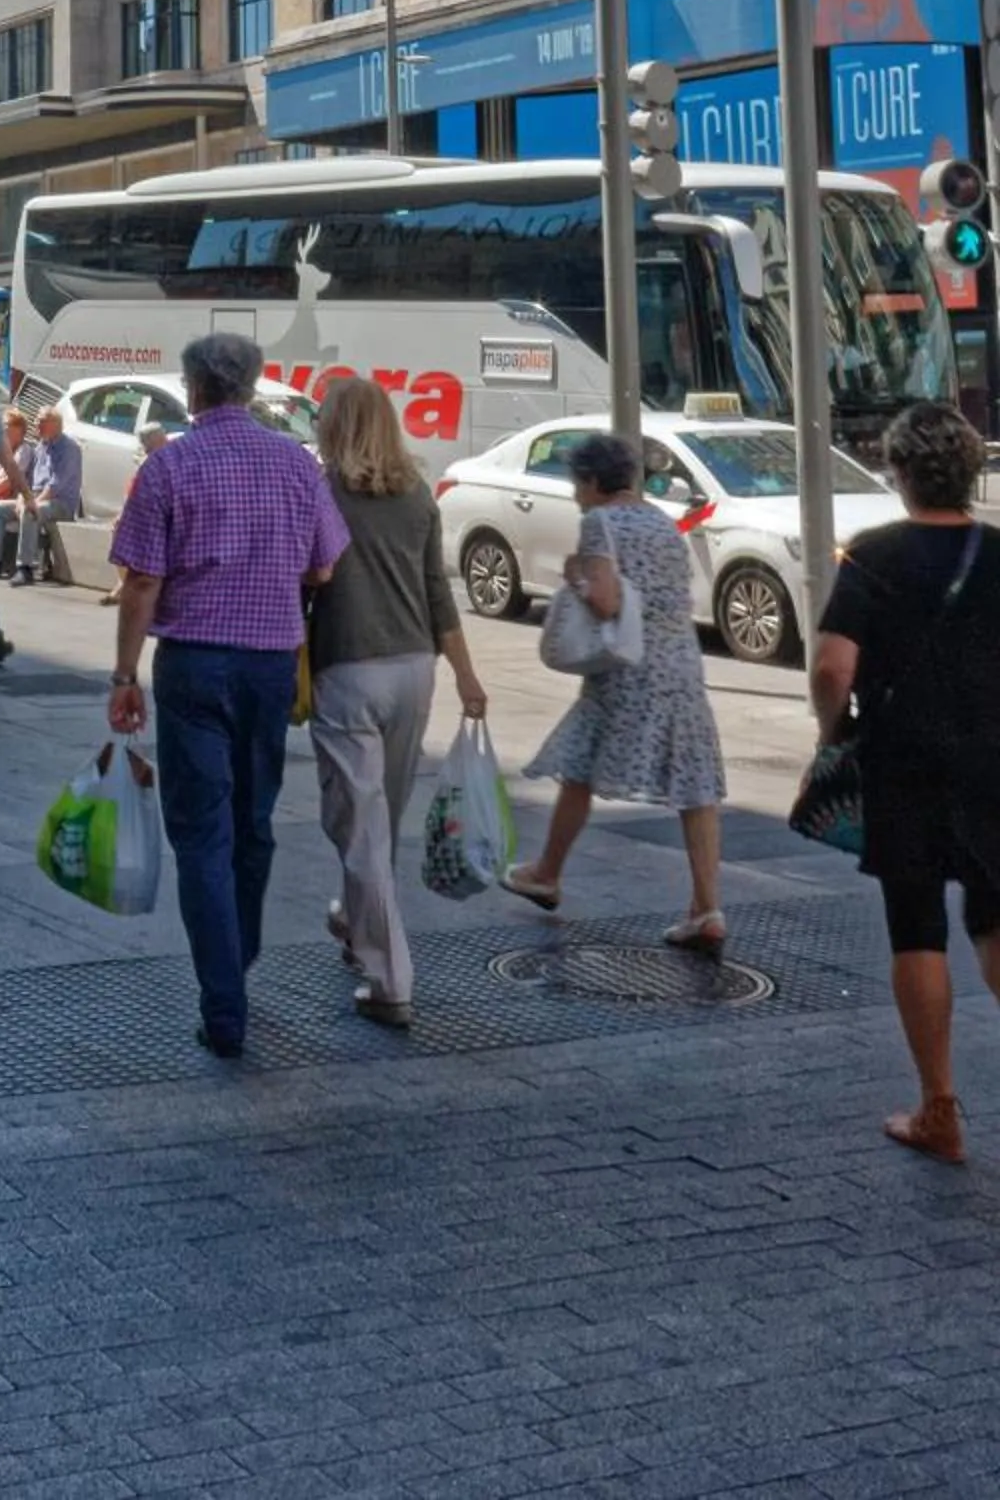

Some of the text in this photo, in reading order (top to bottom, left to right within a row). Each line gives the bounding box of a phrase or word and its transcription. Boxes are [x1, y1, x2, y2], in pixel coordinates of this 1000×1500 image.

[836, 62, 924, 146] I CURE
[50, 342, 162, 365] autocaresvera.com
[481, 348, 550, 373] mapaplus
